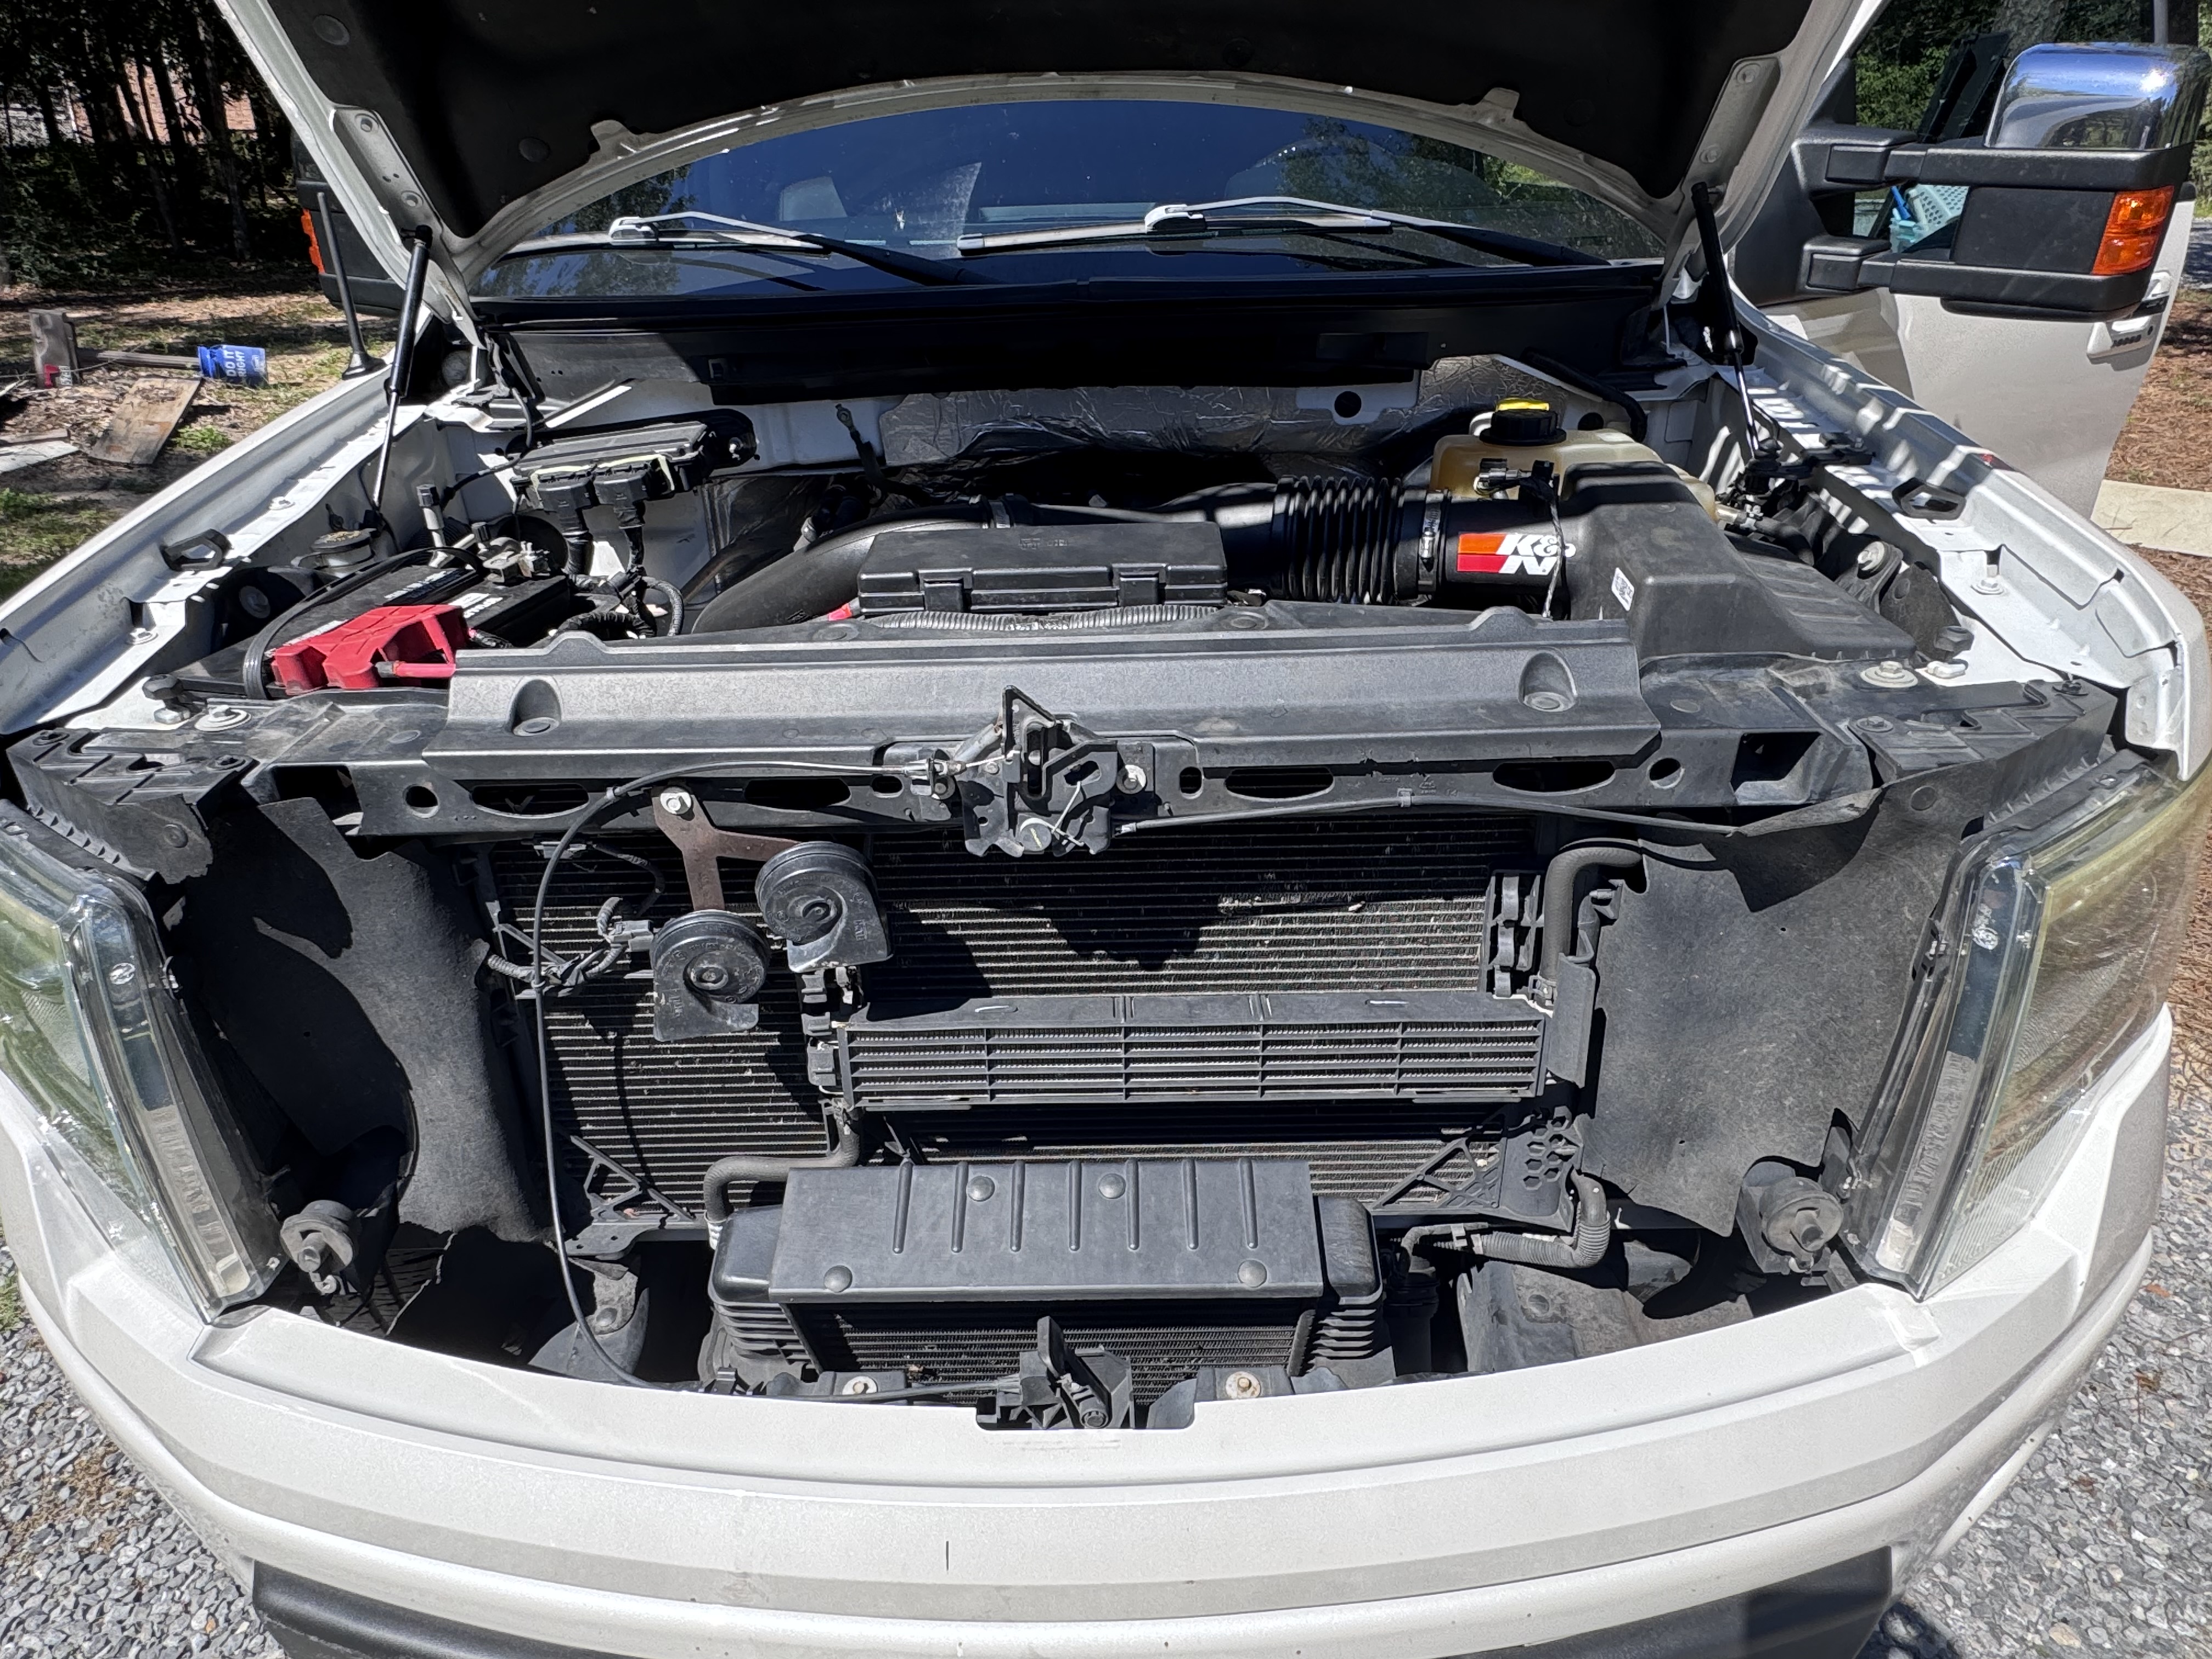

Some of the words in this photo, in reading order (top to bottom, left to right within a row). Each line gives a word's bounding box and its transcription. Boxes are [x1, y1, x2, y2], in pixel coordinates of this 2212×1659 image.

[224, 350, 234, 359] IT
[225, 361, 236, 376] DO
[235, 350, 246, 377] RIGHT
